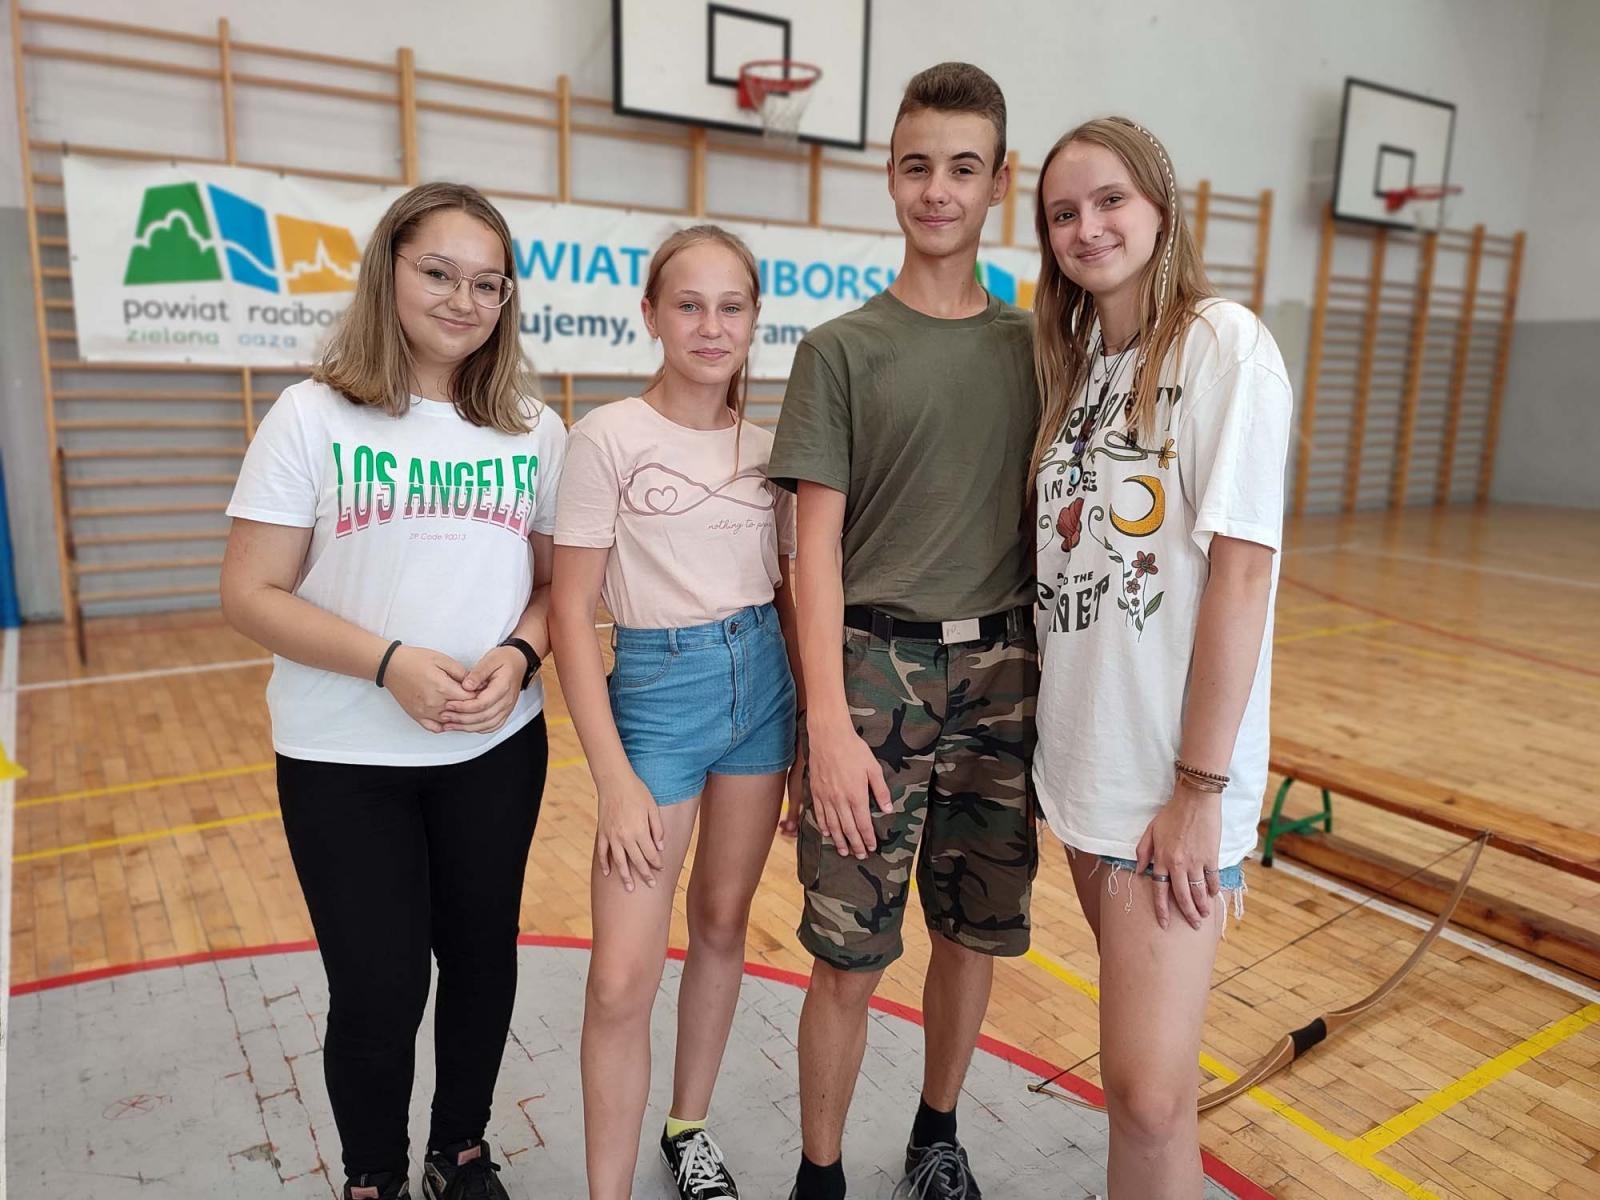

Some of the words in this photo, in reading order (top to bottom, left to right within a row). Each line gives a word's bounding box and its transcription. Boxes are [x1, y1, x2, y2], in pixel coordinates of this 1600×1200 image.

[123, 295, 230, 325] powiat
[127, 327, 220, 345] zielona
[238, 334, 297, 349] oaza
[333, 442, 398, 539] LOS
[403, 455, 538, 543] ANGELES
[708, 519, 742, 535] nothing
[745, 518, 755, 528] to
[420, 532, 443, 541] Code
[1073, 570, 1094, 584] THE
